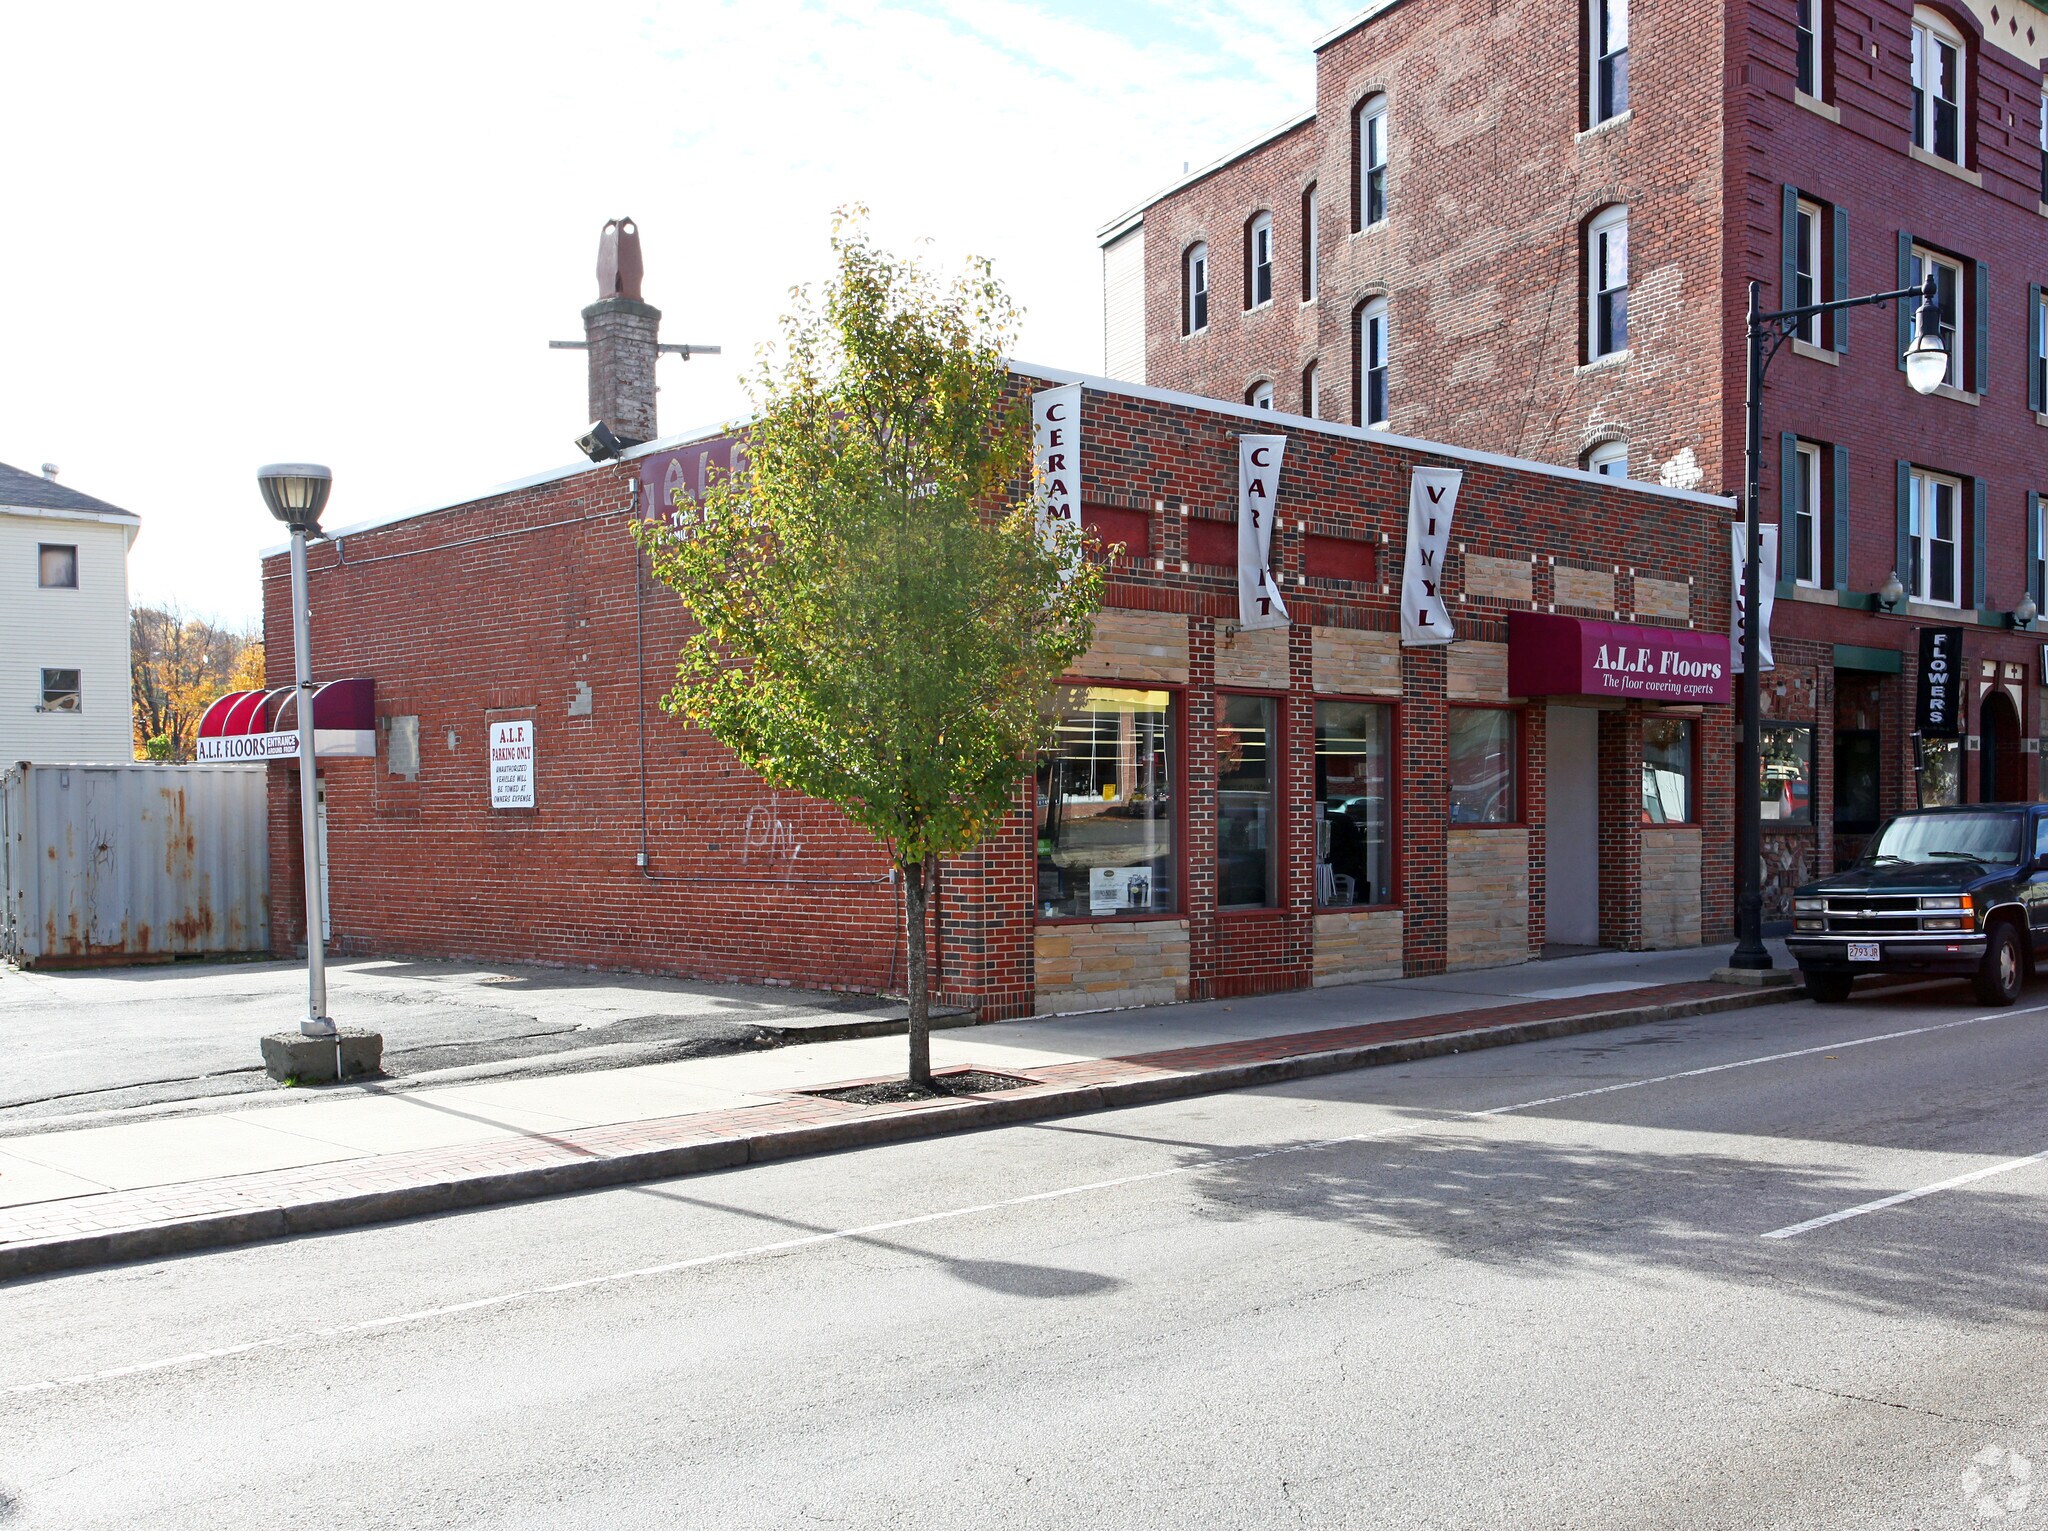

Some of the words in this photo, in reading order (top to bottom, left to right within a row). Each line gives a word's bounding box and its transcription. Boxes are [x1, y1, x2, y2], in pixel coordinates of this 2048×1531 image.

[1046, 403, 1071, 588] CERAM
[1419, 485, 1446, 627] VINYL
[1593, 644, 1653, 673] A.L.F.
[1659, 651, 1721, 679] Floors
[1603, 673, 1619, 687] The
[1621, 675, 1643, 691] floor
[1646, 680, 1681, 695] covering
[1684, 684, 1713, 696] experts
[1928, 634, 1948, 723] FLOWERS
[267, 736, 296, 747] ENTRANCE
[500, 727, 525, 743] A.L.F.
[199, 741, 222, 759] A.L.F.
[225, 737, 265, 758] FLOORS
[492, 747, 515, 761] PARKING
[517, 746, 531, 760] ONLY
[496, 764, 527, 773] UNAUTHORIZED
[496, 775, 515, 783] VEHICLES
[497, 785, 504, 793] BE
[505, 785, 519, 793] TOWED
[494, 795, 510, 803] OWNERS
[512, 794, 532, 803] EXPENSE
[1850, 948, 1868, 957] 2793
[1870, 948, 1878, 957] JR
